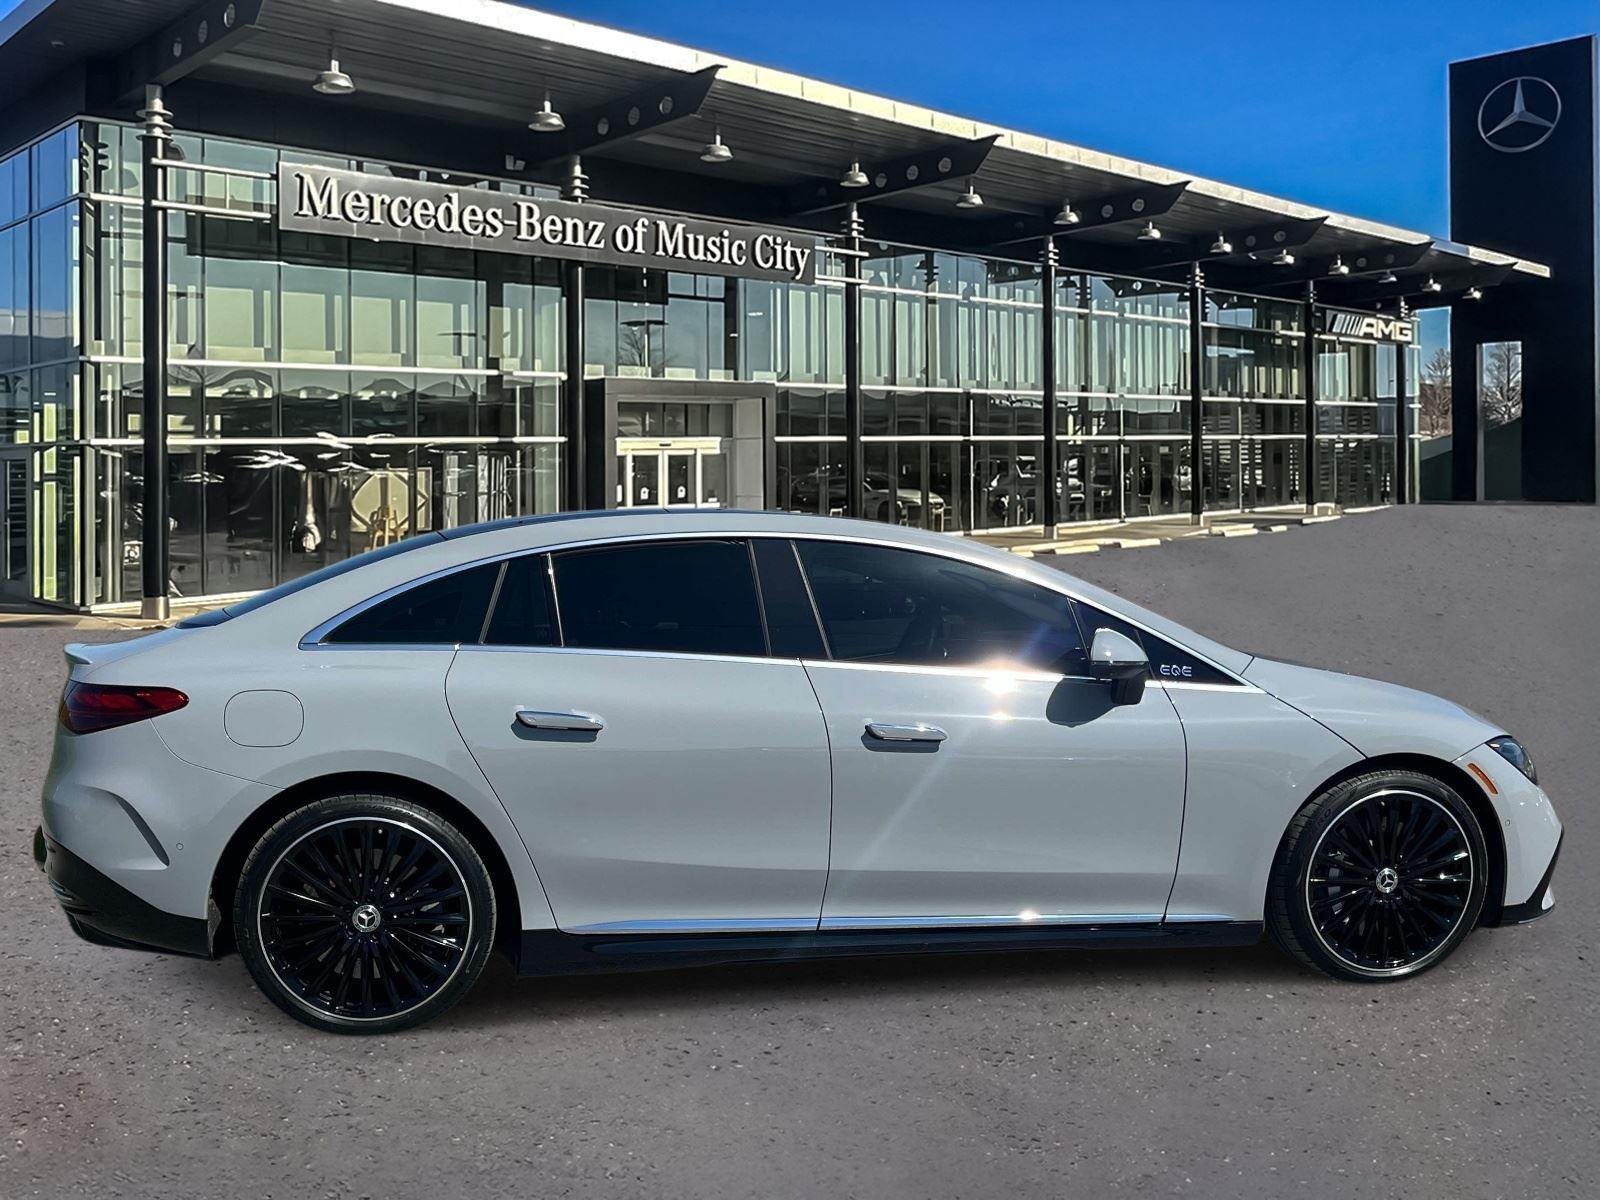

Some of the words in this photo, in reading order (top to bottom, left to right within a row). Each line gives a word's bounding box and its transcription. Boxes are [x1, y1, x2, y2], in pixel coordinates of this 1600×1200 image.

[294, 172, 605, 249] Mercedes-Benz
[614, 217, 649, 254] of
[655, 220, 747, 266] Music
[755, 234, 811, 280] City
[1359, 317, 1413, 342] AMG
[1160, 664, 1192, 677] EQE
